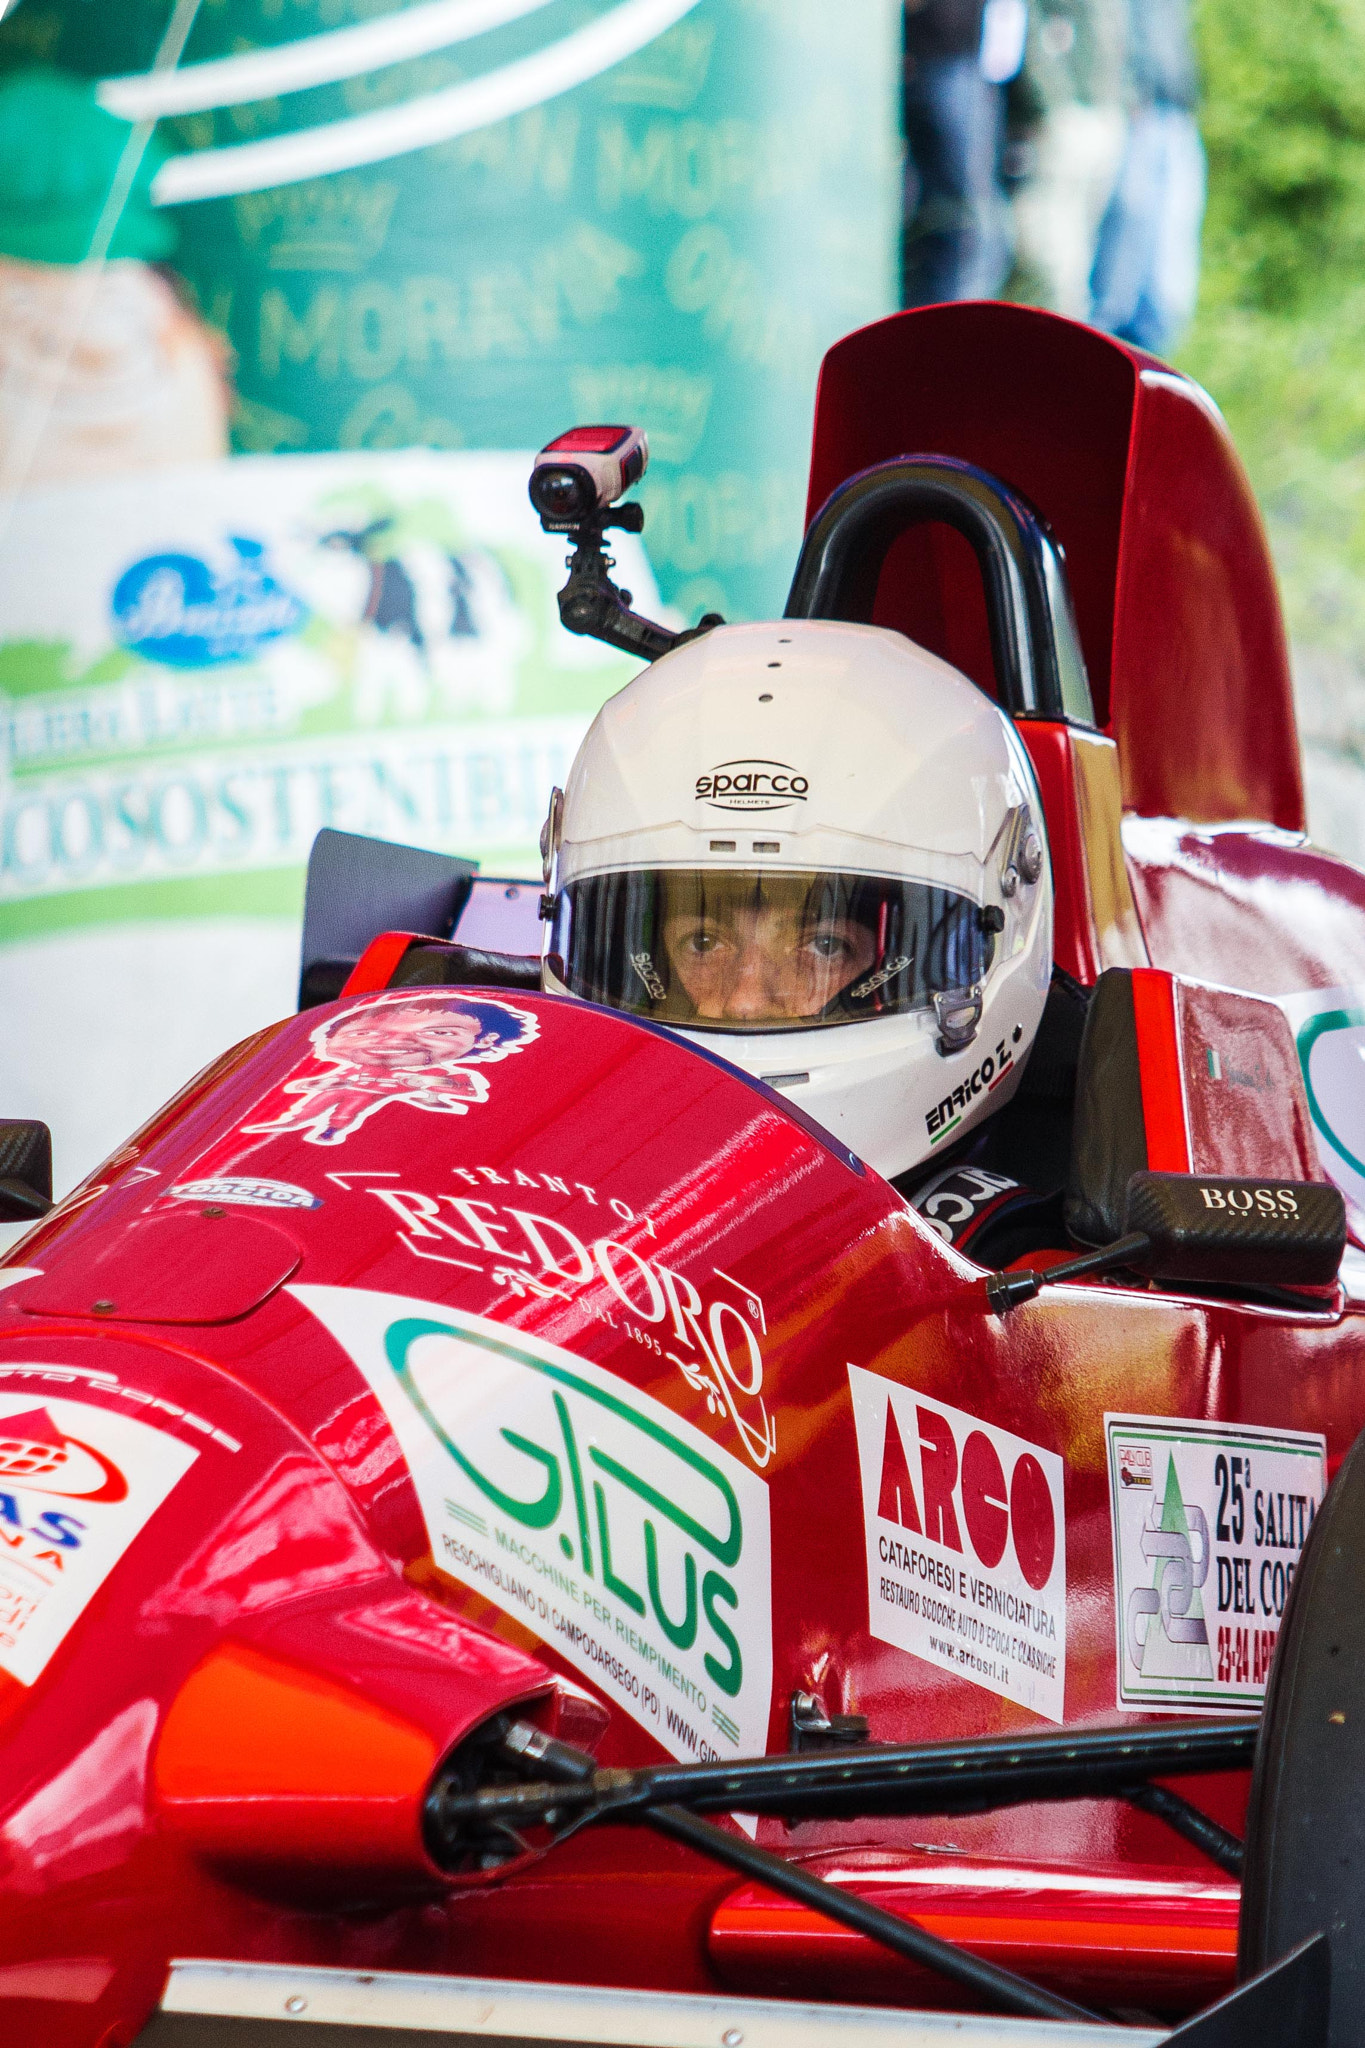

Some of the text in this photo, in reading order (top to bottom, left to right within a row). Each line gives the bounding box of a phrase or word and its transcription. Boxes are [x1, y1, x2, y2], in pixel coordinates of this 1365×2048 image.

[695, 774, 809, 799] sparco
[1199, 1188, 1298, 1213] BOSS
[367, 1189, 770, 1467] REDORO
[578, 1296, 662, 1356] DAL 1895
[877, 1393, 1056, 1591] ARCO
[442, 1533, 536, 1612] RESCHIGLIANO
[538, 1597, 550, 1625] DI
[552, 1607, 639, 1699] CAMPODARSEGO
[641, 1683, 661, 1726] (PD)
[495, 1527, 707, 1713] MACCHINE PER RIEMPIMENTO
[879, 1535, 1057, 1641] CATAFORESI E VERNICIATURA
[880, 1576, 1057, 1679] RESTAURO SCOCCHE AUTO D'EPOCA E CLASSICHE
[1216, 1555, 1256, 1616] DEL
[929, 1634, 1009, 1685] www.arcosrl.it
